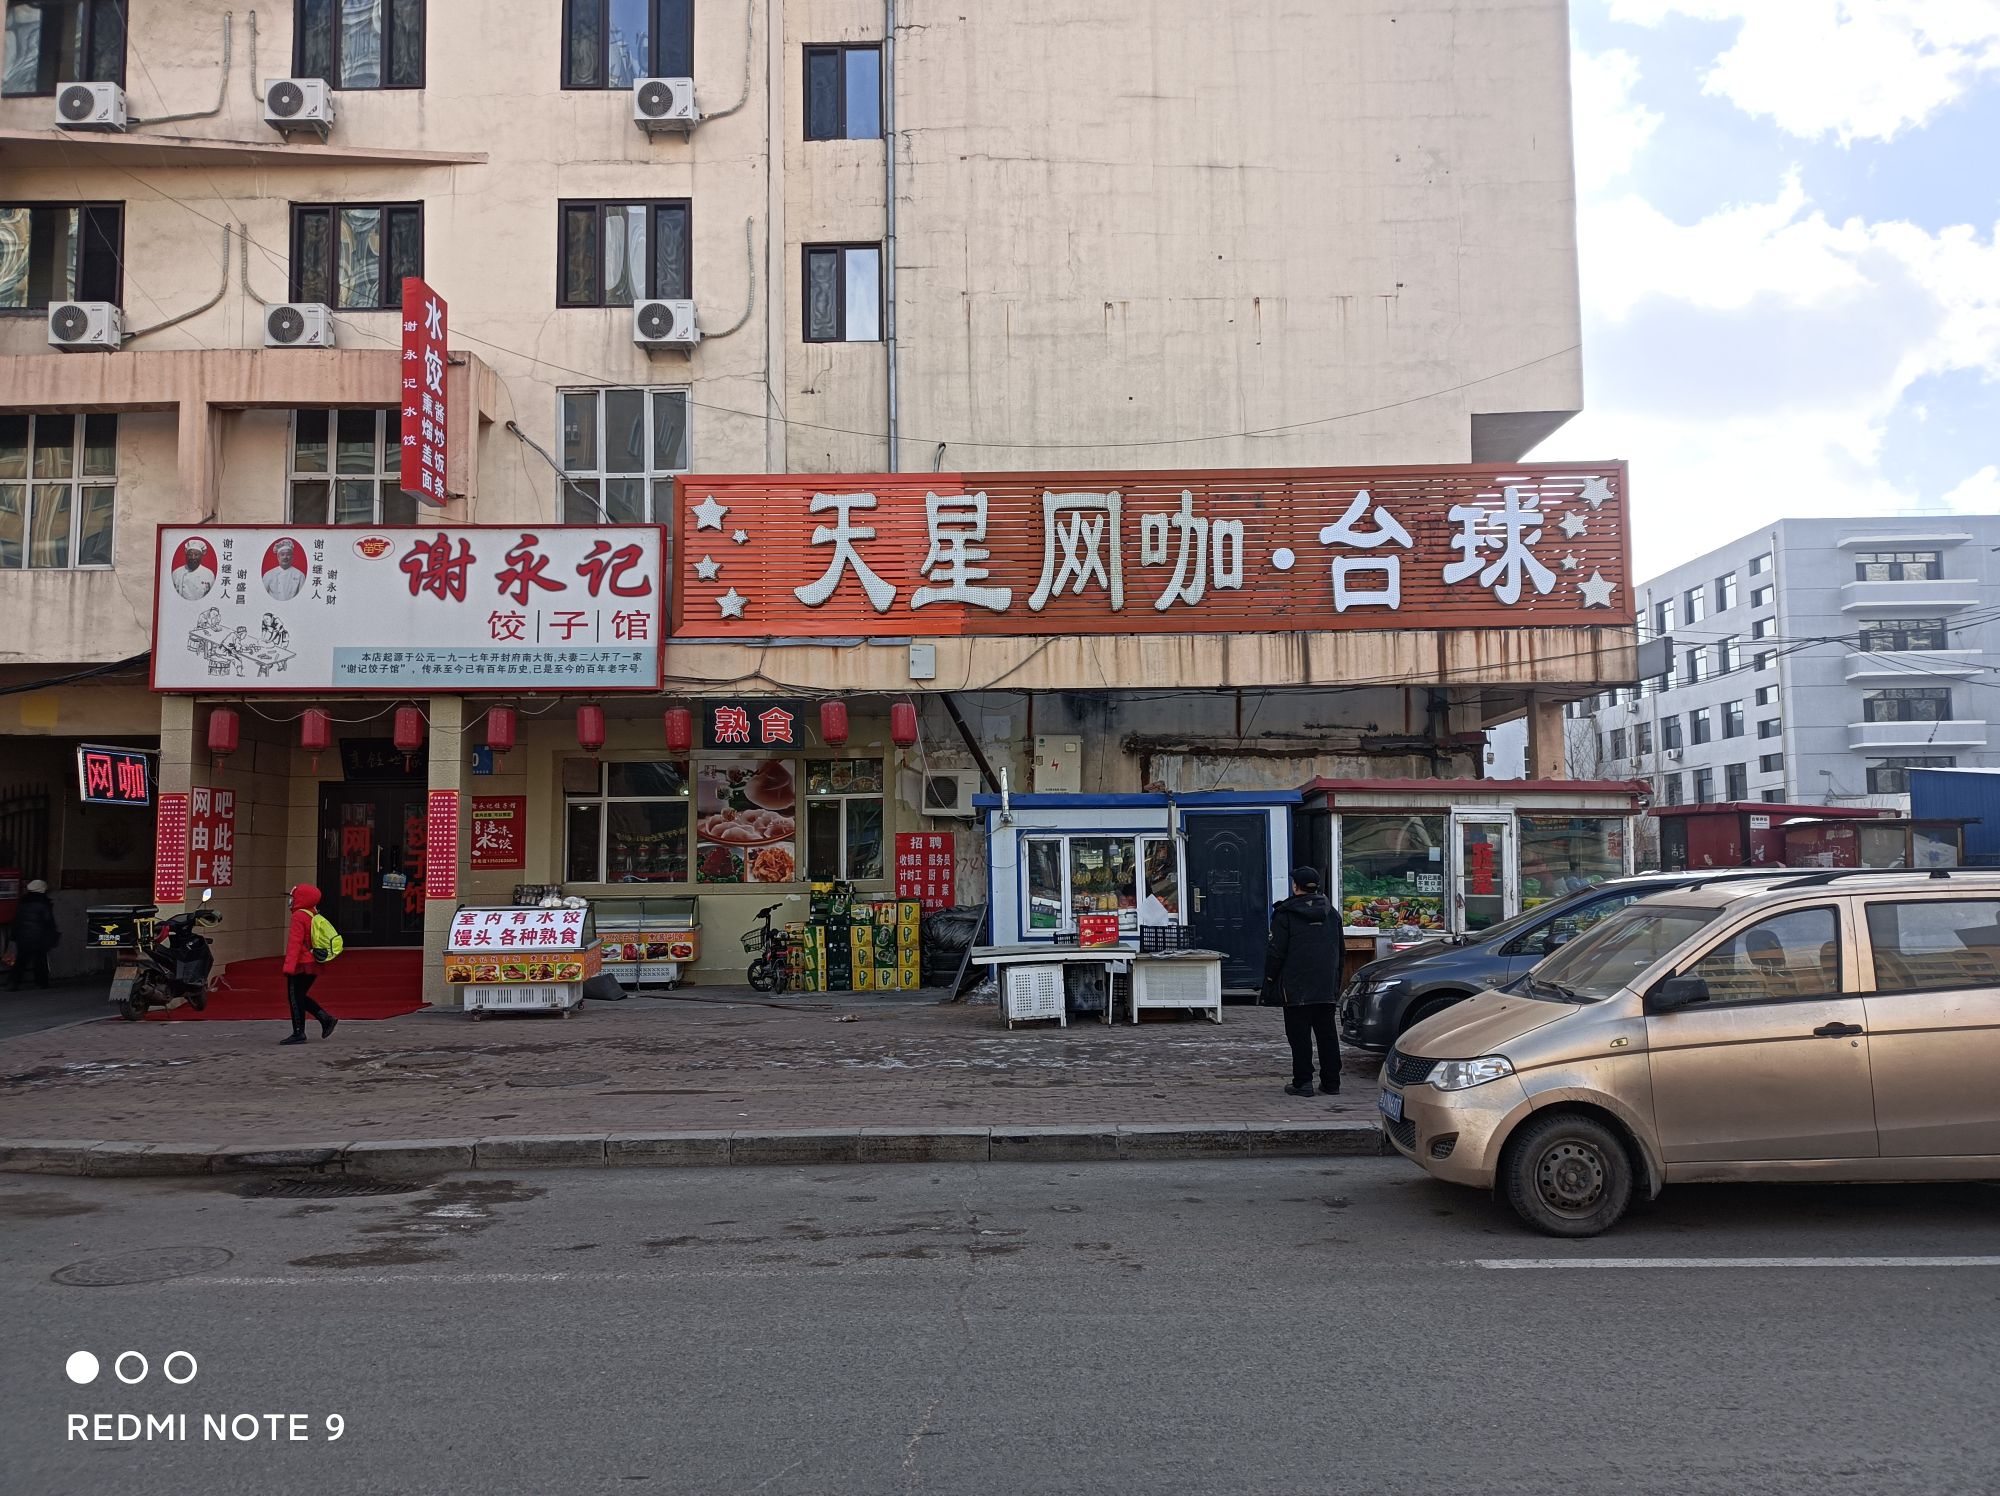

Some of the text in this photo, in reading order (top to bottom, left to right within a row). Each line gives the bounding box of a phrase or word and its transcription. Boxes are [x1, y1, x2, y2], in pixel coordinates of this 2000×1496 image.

[424, 296, 443, 397] 水饺
[403, 321, 419, 447] 谢永记水饺
[219, 538, 234, 600] 谢记继承人
[235, 568, 248, 605] 谢盛昌
[311, 538, 325, 600] 谢记继承人
[399, 532, 654, 607] 谢永记
[714, 705, 795, 744] 熟食
[86, 753, 146, 799] 网咖
[192, 787, 234, 819] 网吧
[191, 821, 233, 852] 由此
[910, 836, 943, 850] 招聘
[188, 854, 232, 886] 上楼
[341, 827, 373, 902] 网吧
[899, 853, 951, 866] 收银员 服务员
[899, 868, 950, 881] 计时工 厨师
[453, 926, 578, 947] 馒头 各种熟食
[456, 910, 582, 926] 室内有水饺
